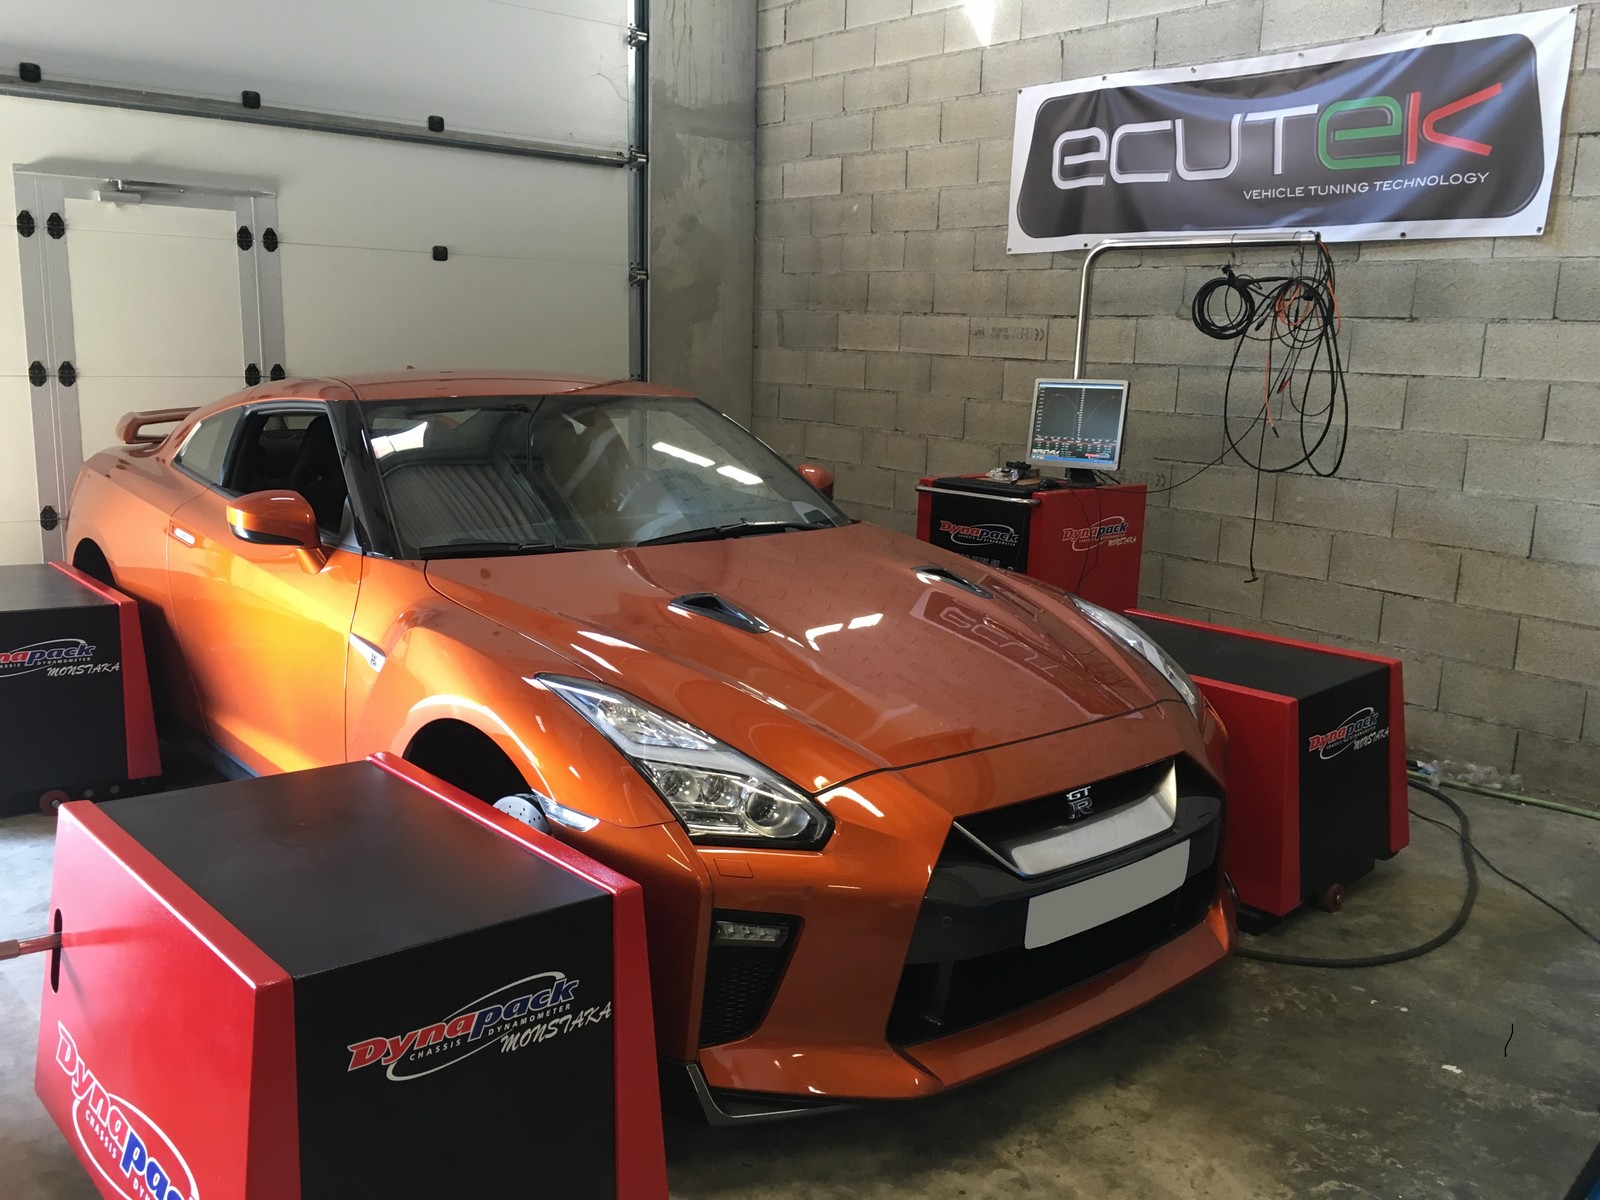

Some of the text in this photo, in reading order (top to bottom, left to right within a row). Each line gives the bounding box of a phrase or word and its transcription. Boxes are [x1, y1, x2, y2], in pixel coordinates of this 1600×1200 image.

[1243, 172, 1490, 200] VEHICLE TUNING TECHNOLOGY
[940, 520, 1019, 543] Dynapack
[37, 657, 91, 666] DYNAMOMETER
[46, 662, 120, 677] MONSTAKA
[1308, 711, 1379, 752] Dynapack
[1066, 785, 1092, 800] GT
[1068, 797, 1093, 819] R
[347, 978, 579, 1072] Dynapack
[409, 1003, 571, 1061] CHASSIS DYNAMOMETER
[499, 1000, 612, 1054] MONSTAKA
[56, 1020, 188, 1200] Dynapa
[85, 1110, 117, 1159] CHASSIS
